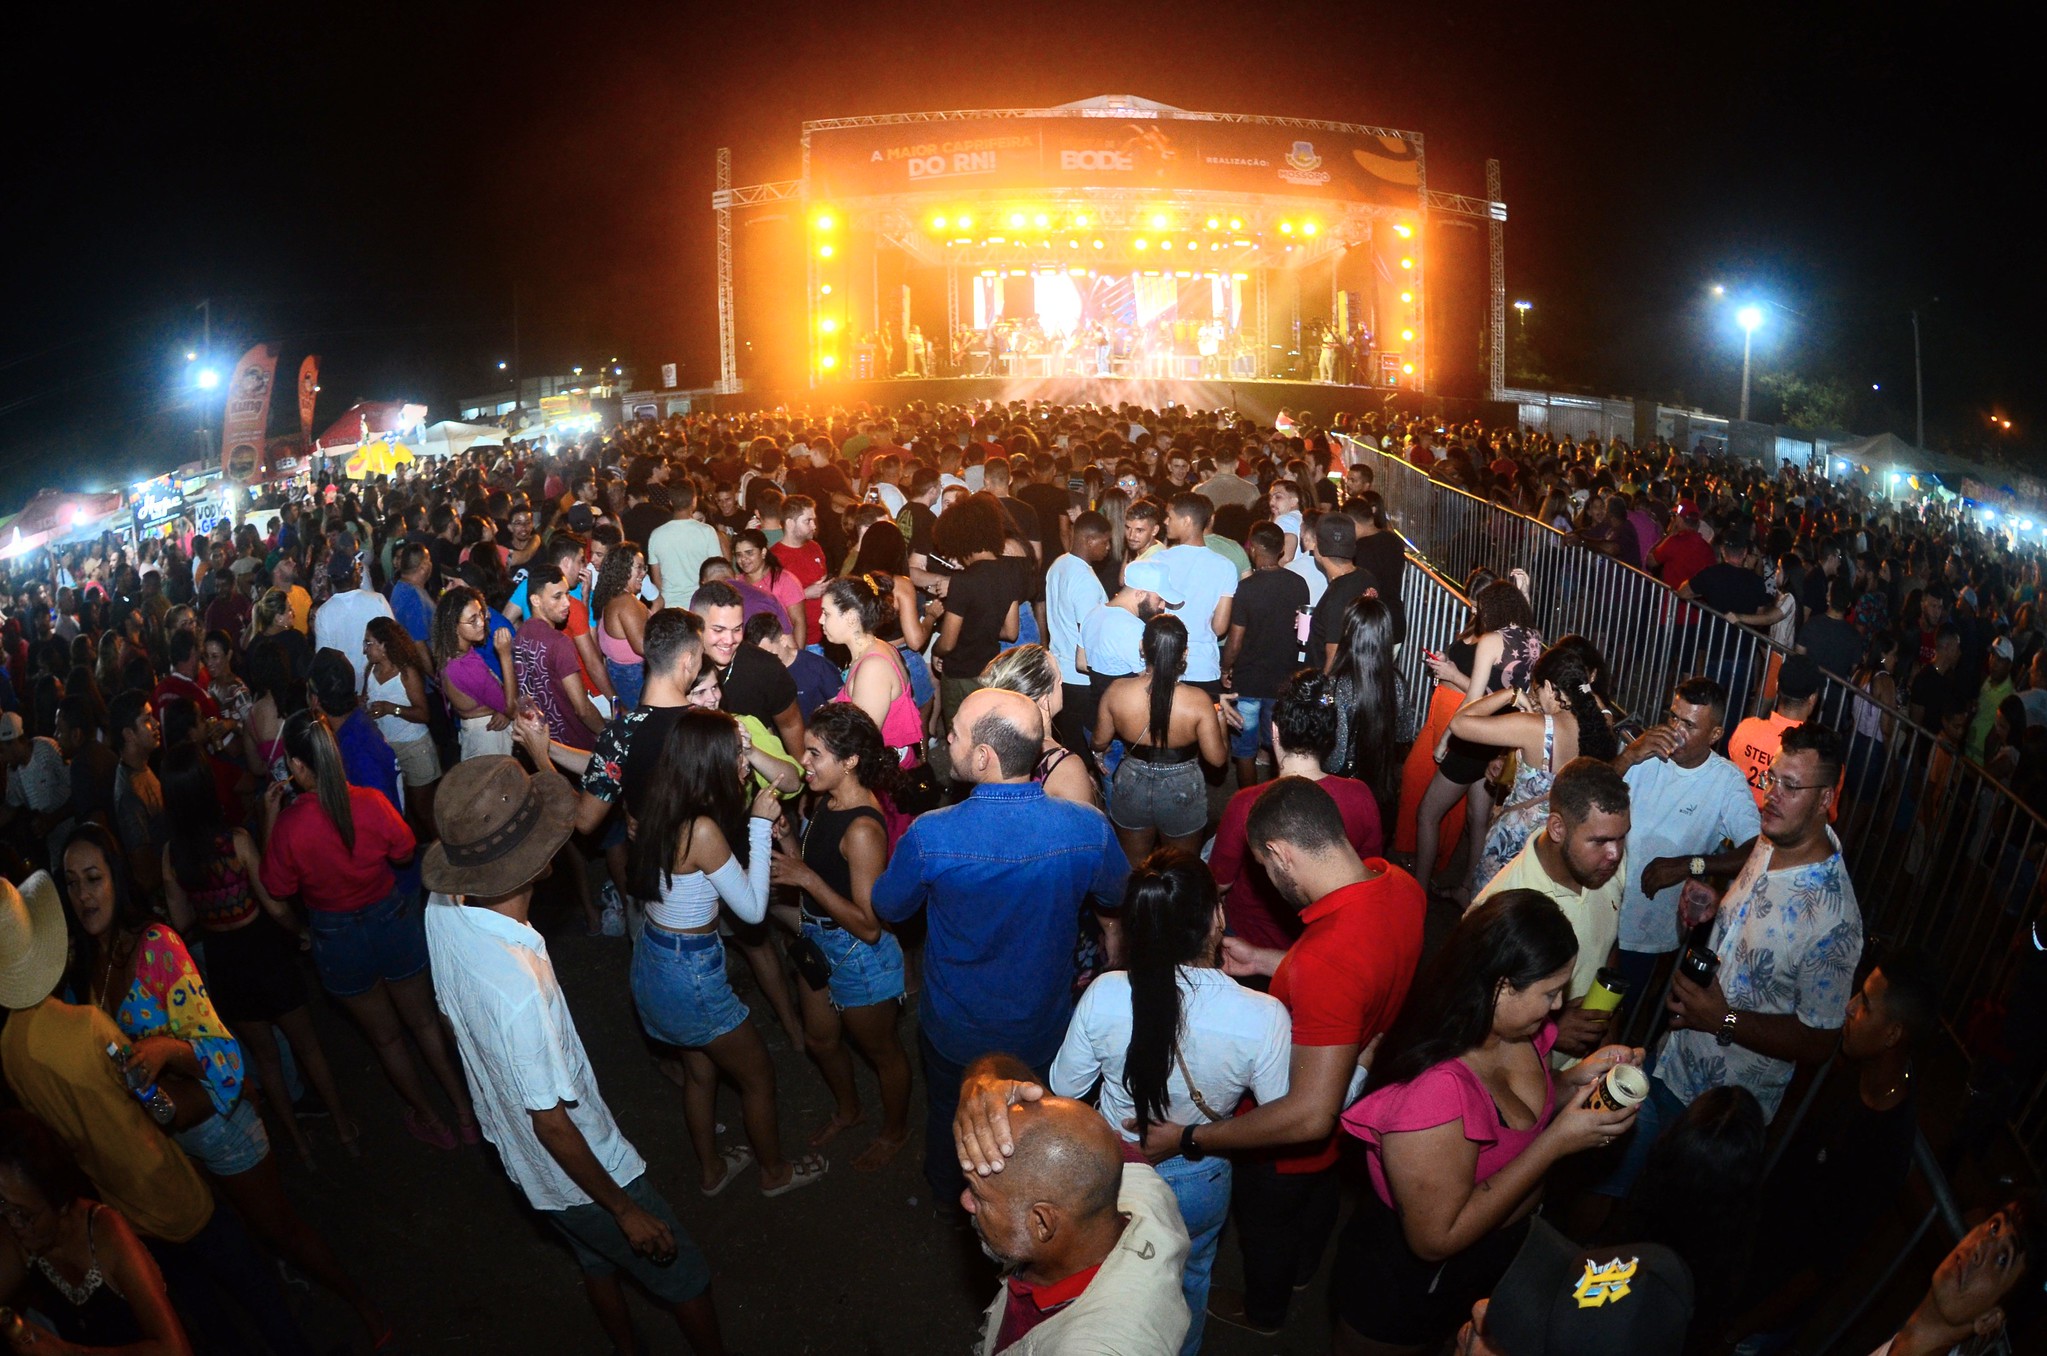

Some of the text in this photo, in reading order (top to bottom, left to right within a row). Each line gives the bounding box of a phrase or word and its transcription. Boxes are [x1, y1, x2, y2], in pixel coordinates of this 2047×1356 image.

[870, 136, 1033, 162] A MAIOR CAPRIFEIRA
[1060, 150, 1133, 171] BODE
[908, 151, 997, 177] DO RN!
